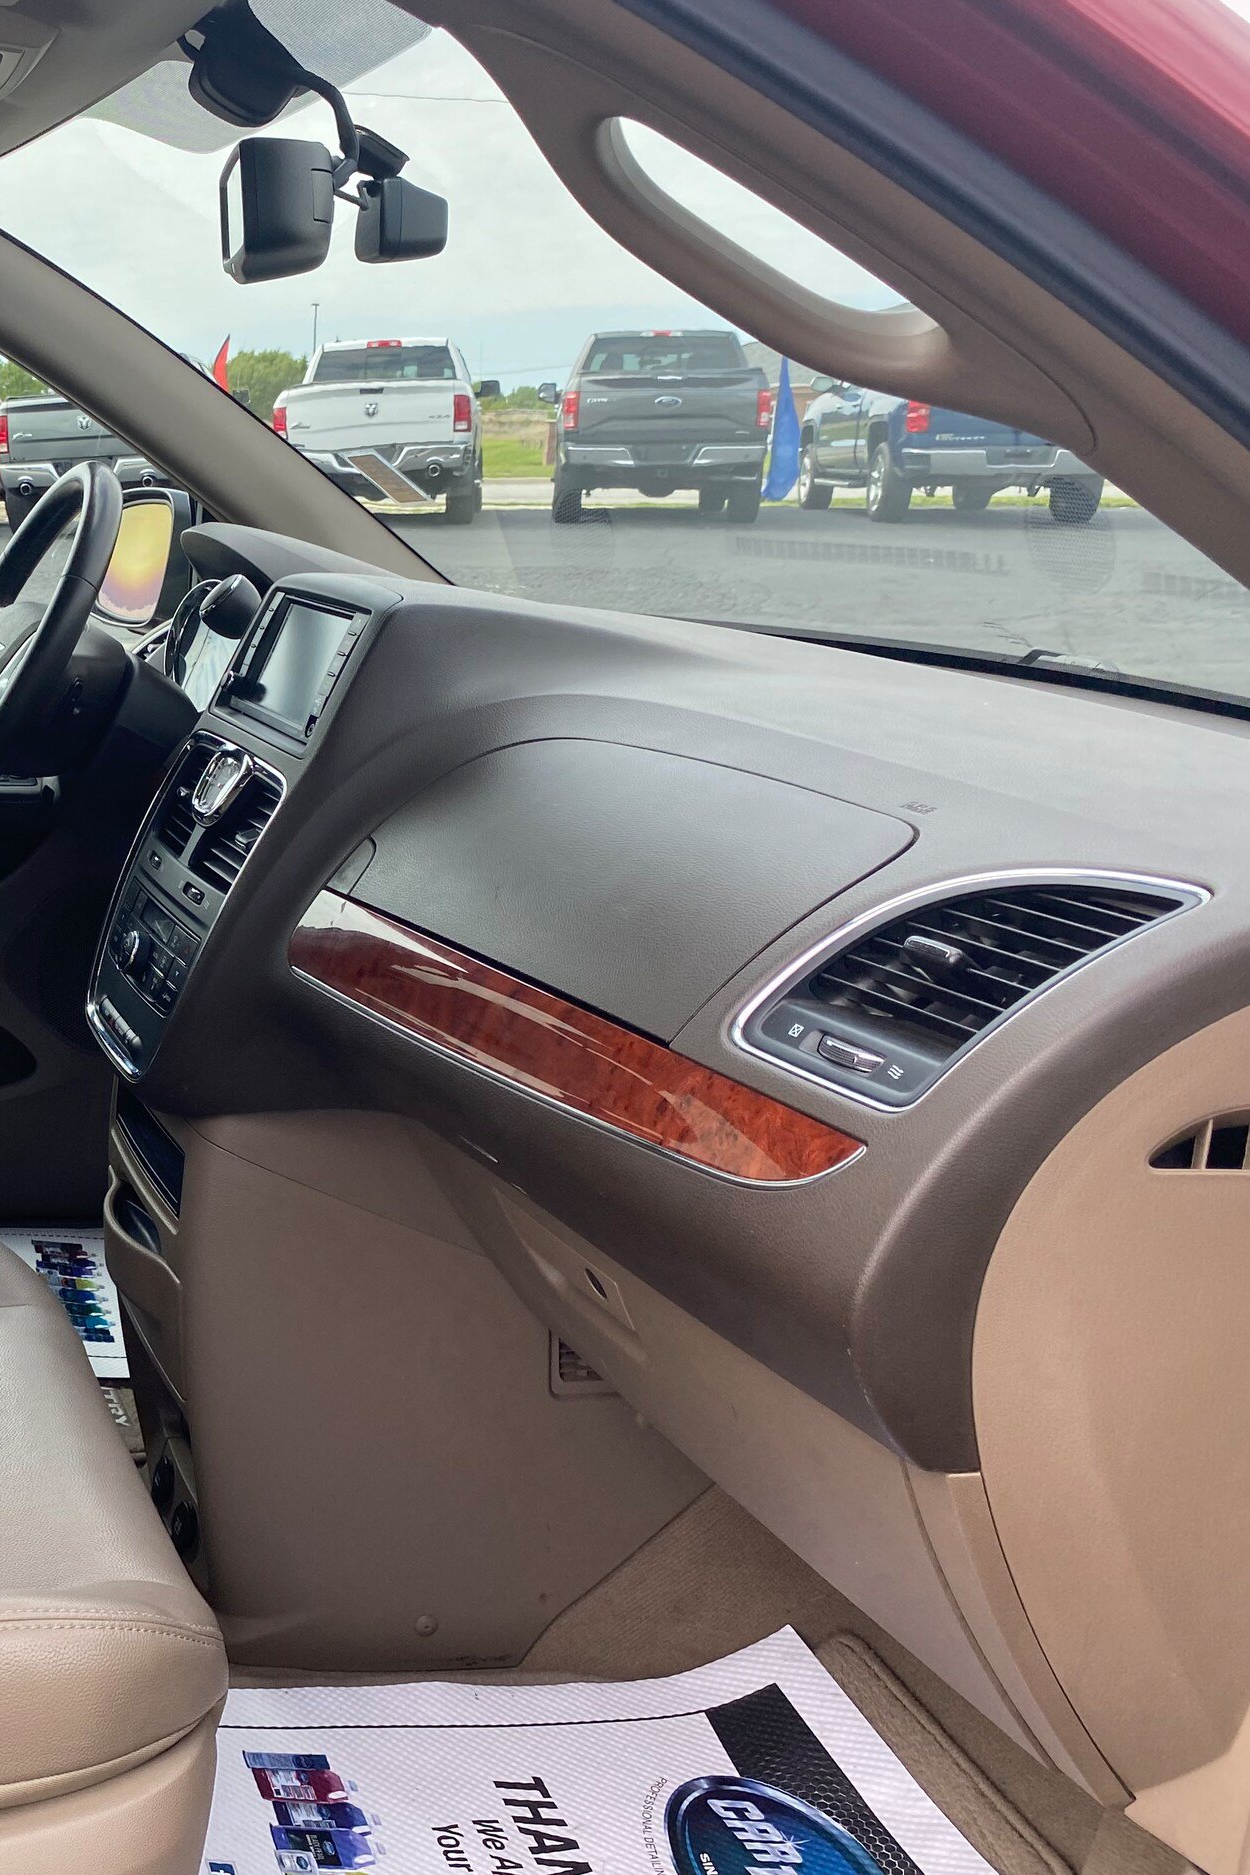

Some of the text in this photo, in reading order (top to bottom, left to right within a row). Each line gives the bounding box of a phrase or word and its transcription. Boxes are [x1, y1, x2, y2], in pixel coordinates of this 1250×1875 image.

[640, 1777, 668, 1838] PROFESSIONAL
[431, 1824, 474, 1873] Your
[472, 1820, 509, 1850] We
